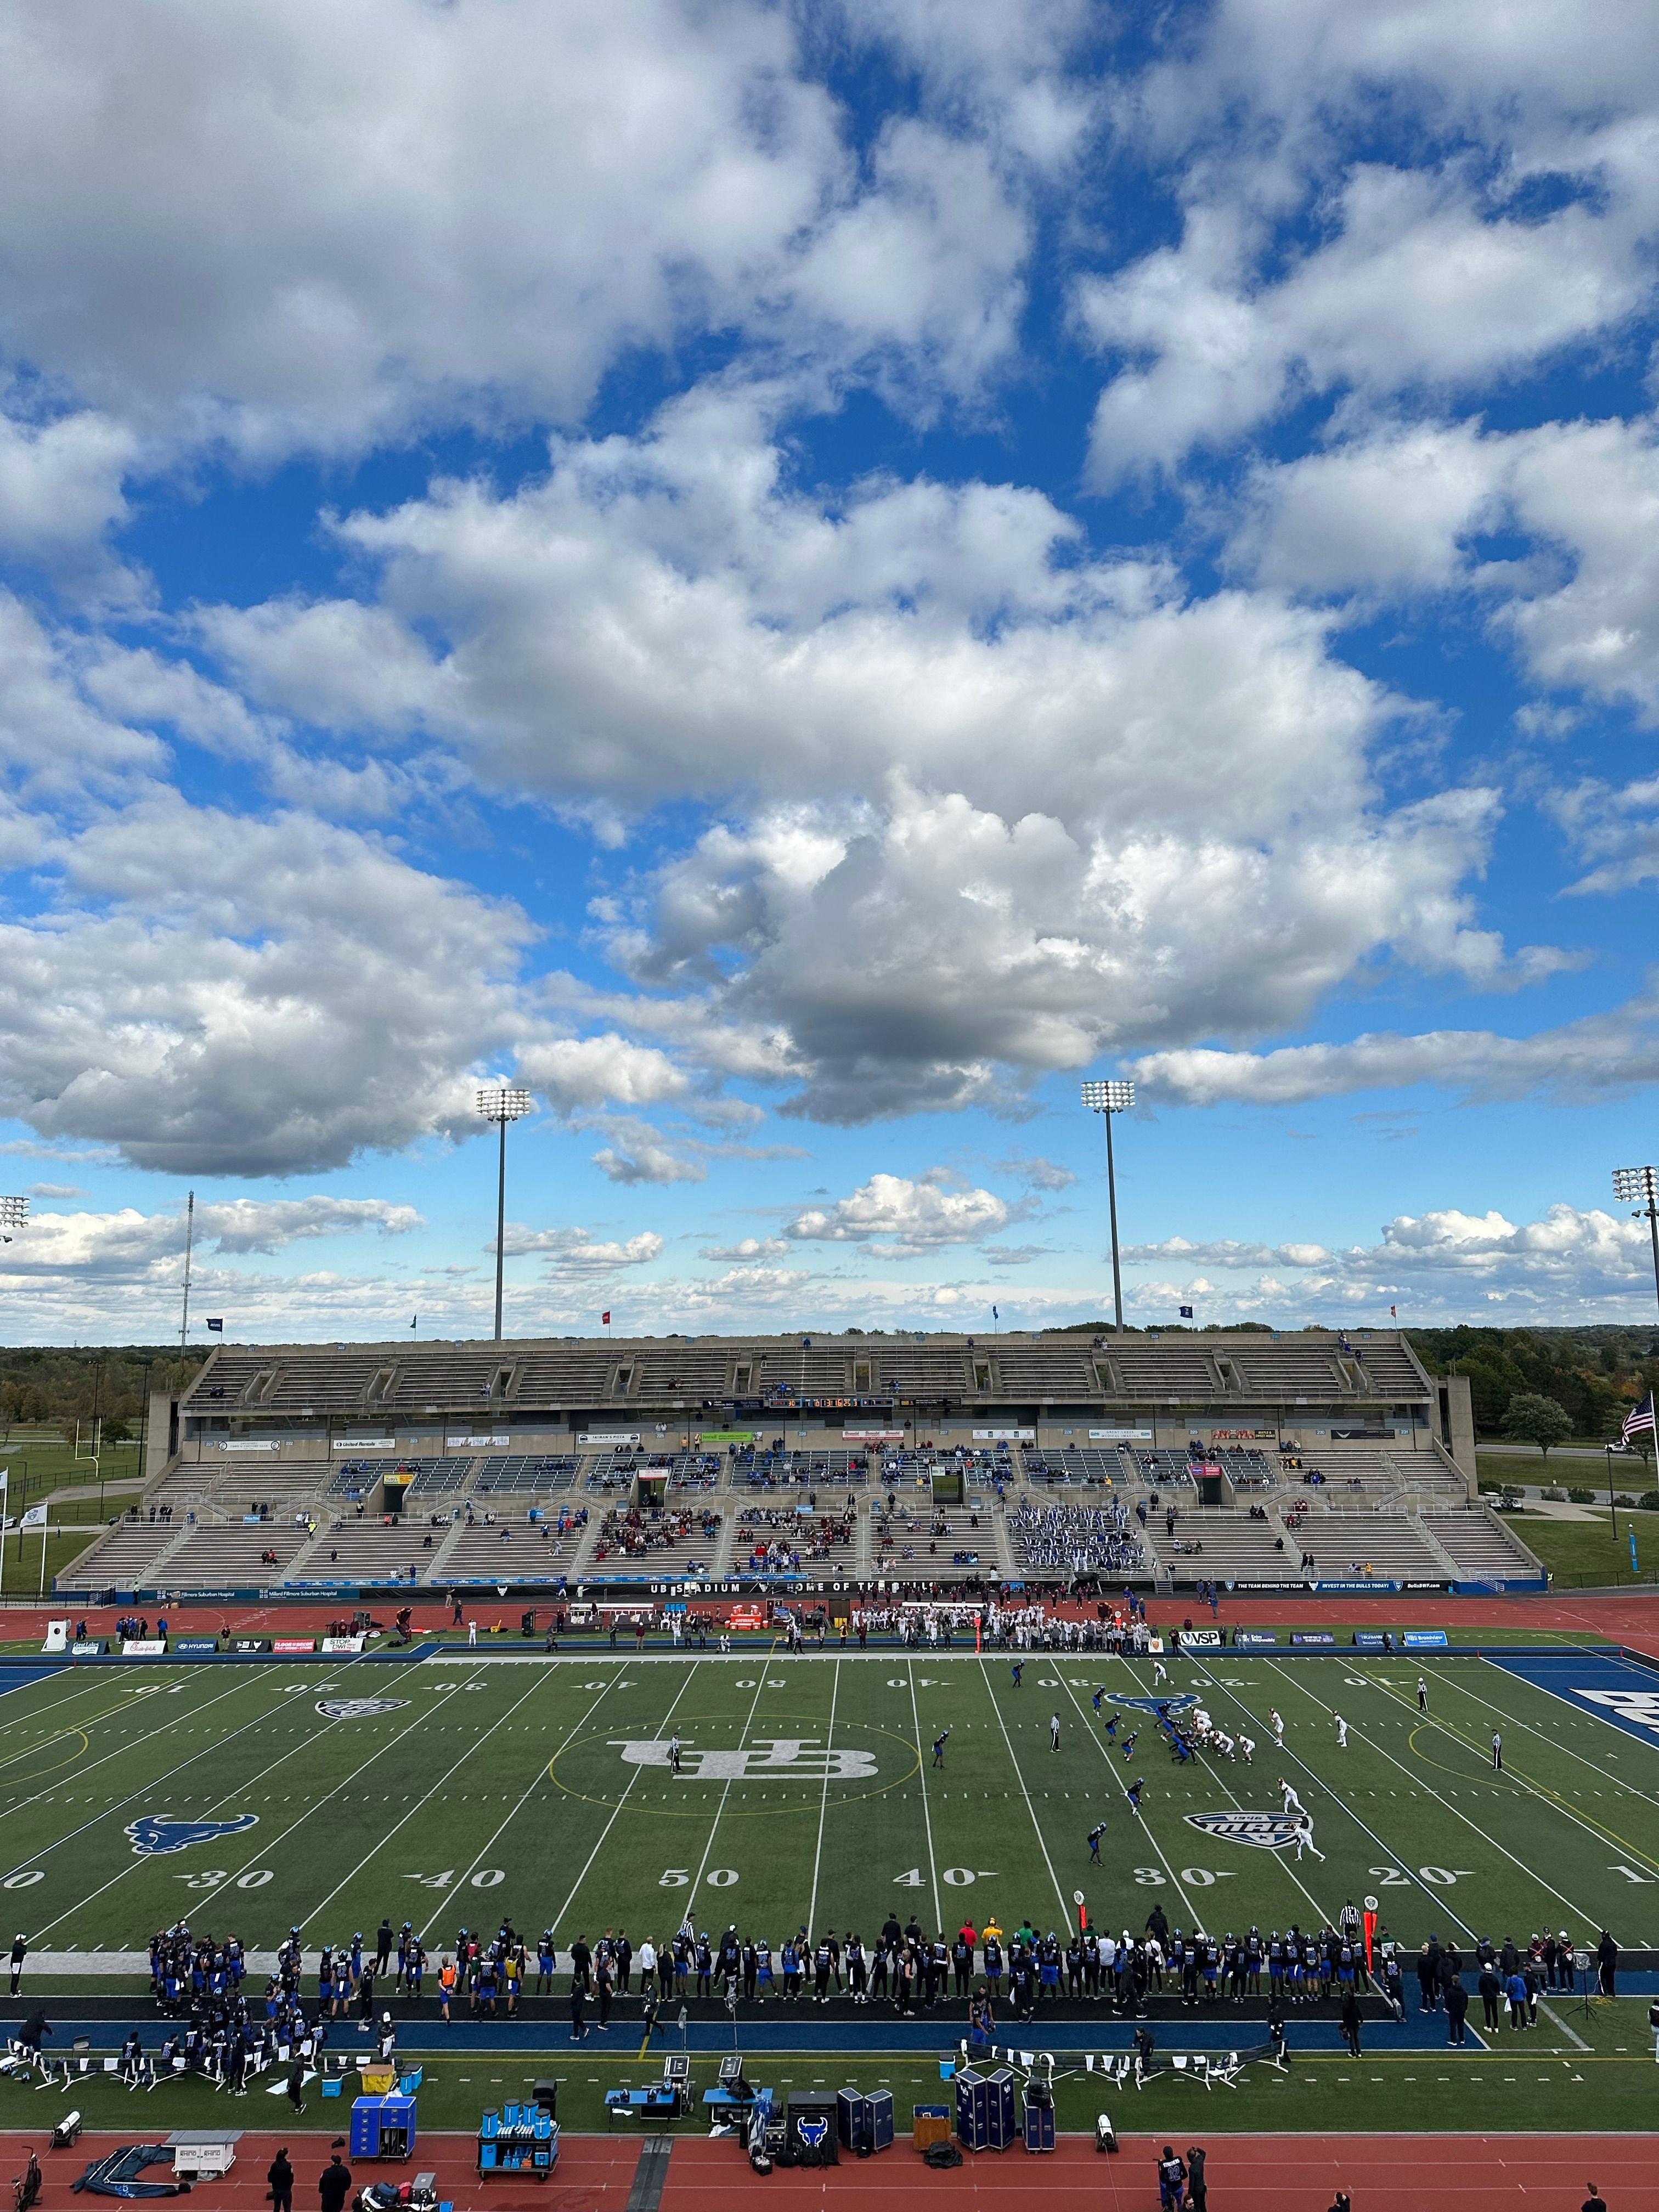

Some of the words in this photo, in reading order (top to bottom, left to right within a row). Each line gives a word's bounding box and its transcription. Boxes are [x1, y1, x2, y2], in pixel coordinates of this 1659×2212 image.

[651, 1584, 667, 1593] UB
[676, 1583, 740, 1593] SADIUM
[833, 1582, 849, 1591] OF
[1192, 1632, 1217, 1644] VSP
[605, 1739, 878, 1780] UB
[1204, 1822, 1296, 1832] MAC
[187, 1870, 274, 1888] 30
[420, 1869, 505, 1888] 40
[658, 1869, 740, 1887] 50
[893, 1868, 975, 1886] 40
[1133, 1868, 1216, 1886] 30
[1368, 1866, 1457, 1885] 20
[1606, 1865, 1657, 1883] 1
[337, 1965, 347, 1977] 42
[294, 2022, 305, 2037] 82
[125, 2046, 133, 2059] 5
